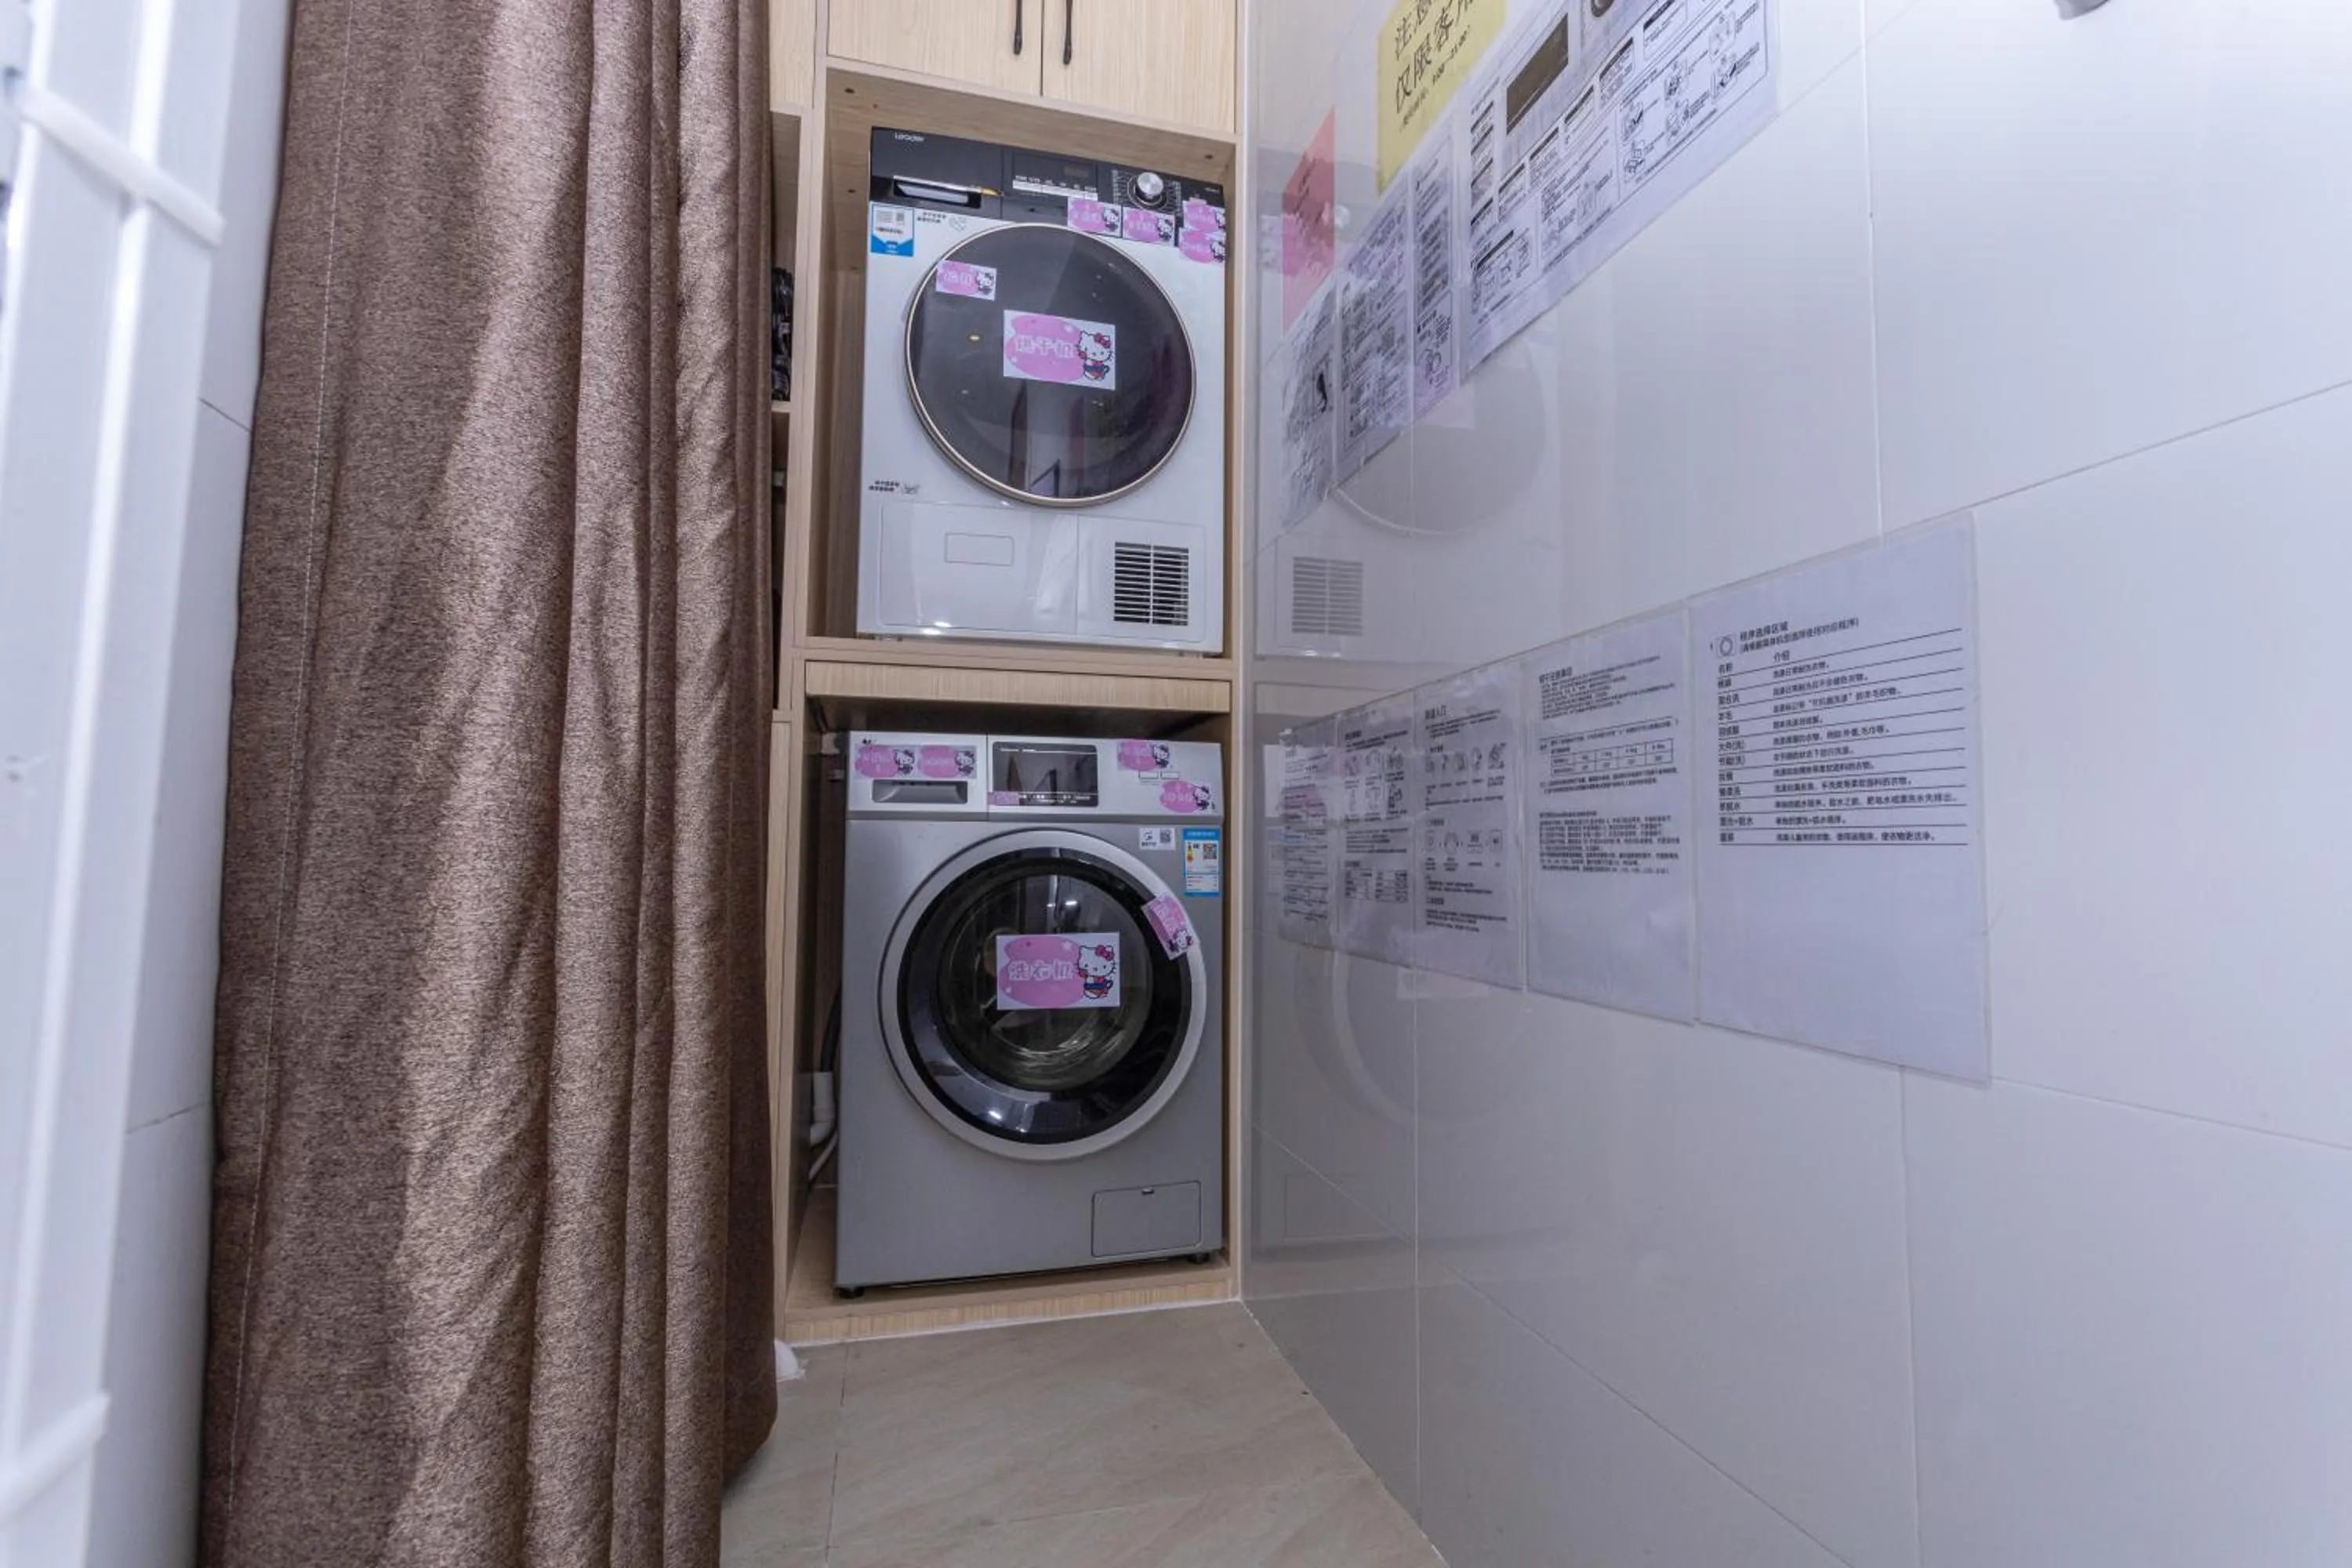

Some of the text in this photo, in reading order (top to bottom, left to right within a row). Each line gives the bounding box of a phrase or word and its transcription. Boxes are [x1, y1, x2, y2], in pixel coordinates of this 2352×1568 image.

[1014, 334, 1075, 359] 烘干机
[1007, 958, 1076, 982] 洗衣机
